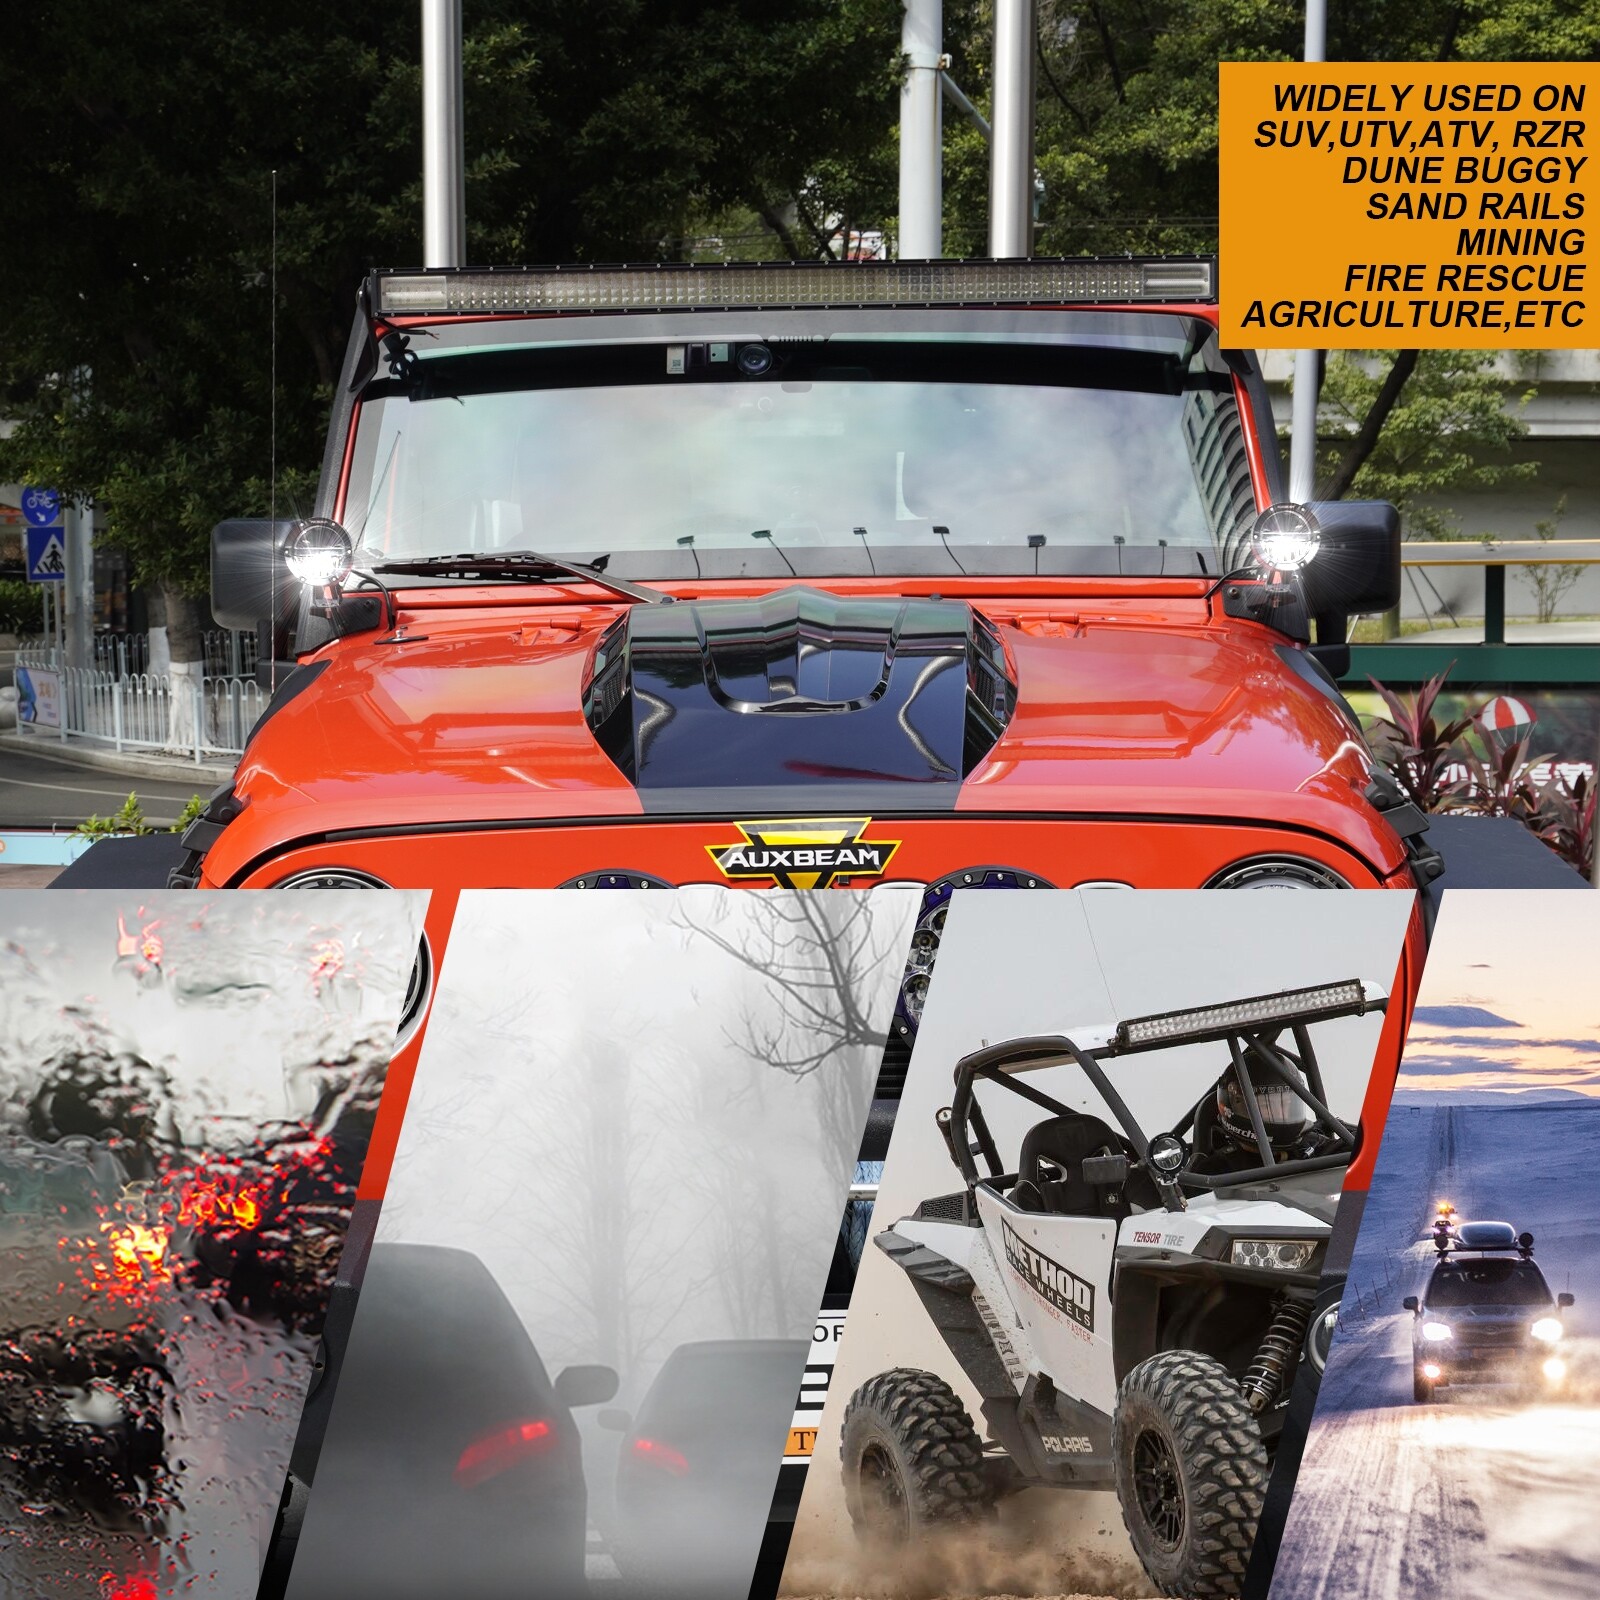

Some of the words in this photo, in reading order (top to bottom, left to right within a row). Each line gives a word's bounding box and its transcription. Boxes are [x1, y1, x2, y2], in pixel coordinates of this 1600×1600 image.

[726, 849, 879, 868] AUXBEAM
[1133, 1231, 1161, 1244] TENSOR
[1163, 1234, 1185, 1246] TIRE
[1003, 1224, 1092, 1312] METHOD
[1006, 1248, 1031, 1282] RACE
[1035, 1279, 1091, 1327] WHEELS
[1042, 1436, 1093, 1453] POLARIS
